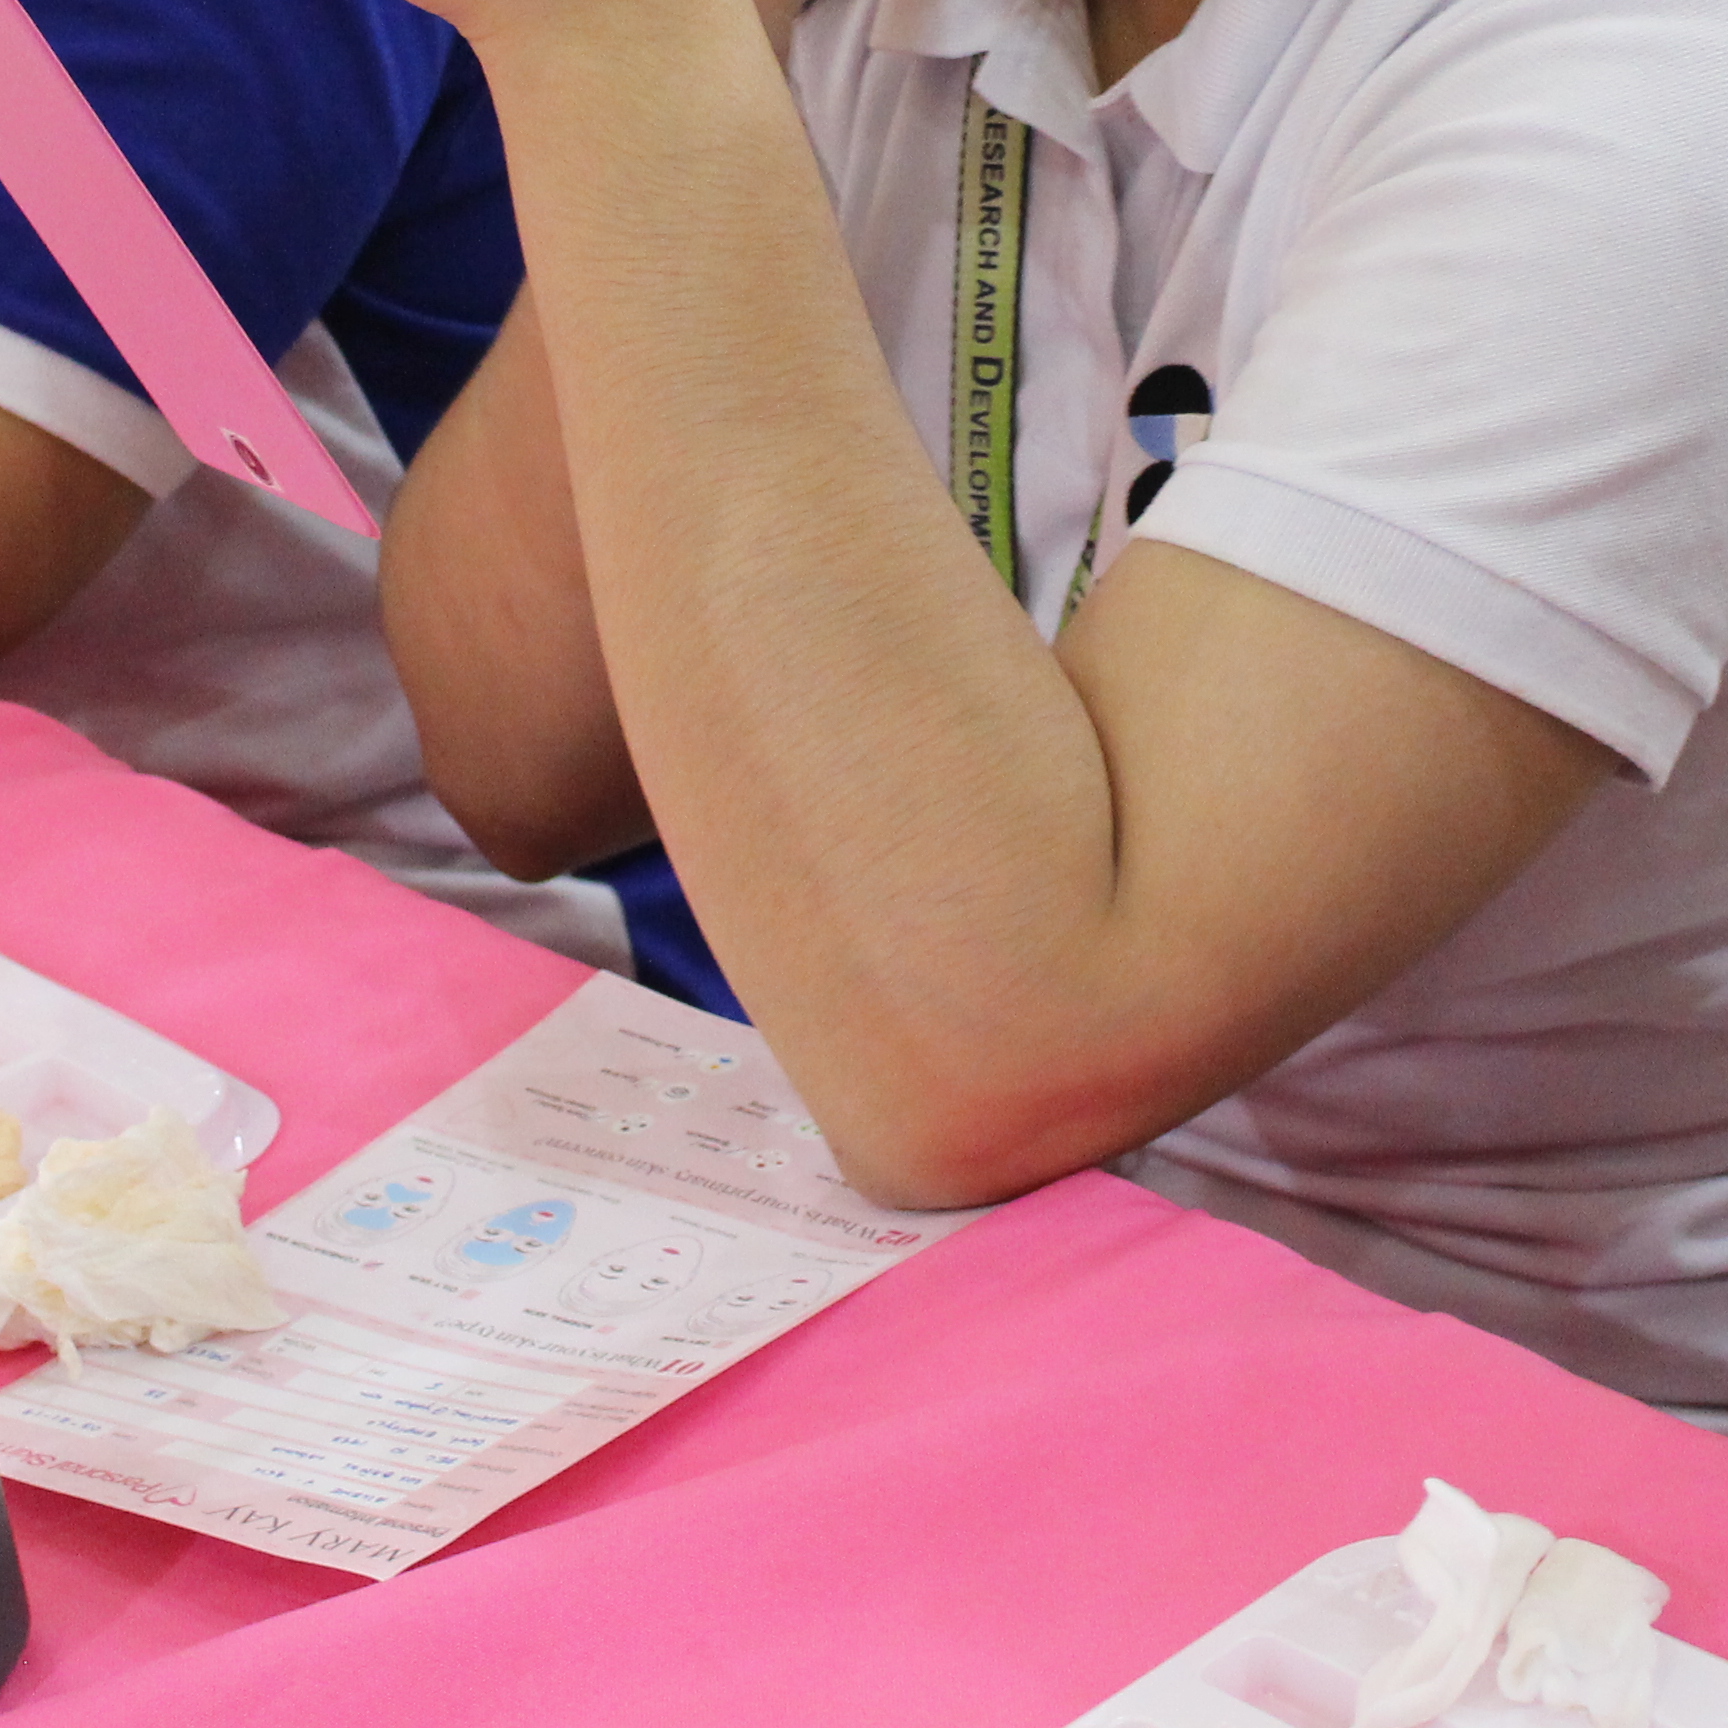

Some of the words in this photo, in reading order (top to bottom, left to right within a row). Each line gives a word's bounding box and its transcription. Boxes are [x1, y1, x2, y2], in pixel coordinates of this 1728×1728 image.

[975, 280, 997, 344] AND
[601, 1352, 668, 1368] What
[47, 1456, 158, 1494] Personal
[201, 1503, 292, 1535] KAY
[289, 1529, 415, 1563] MARY
